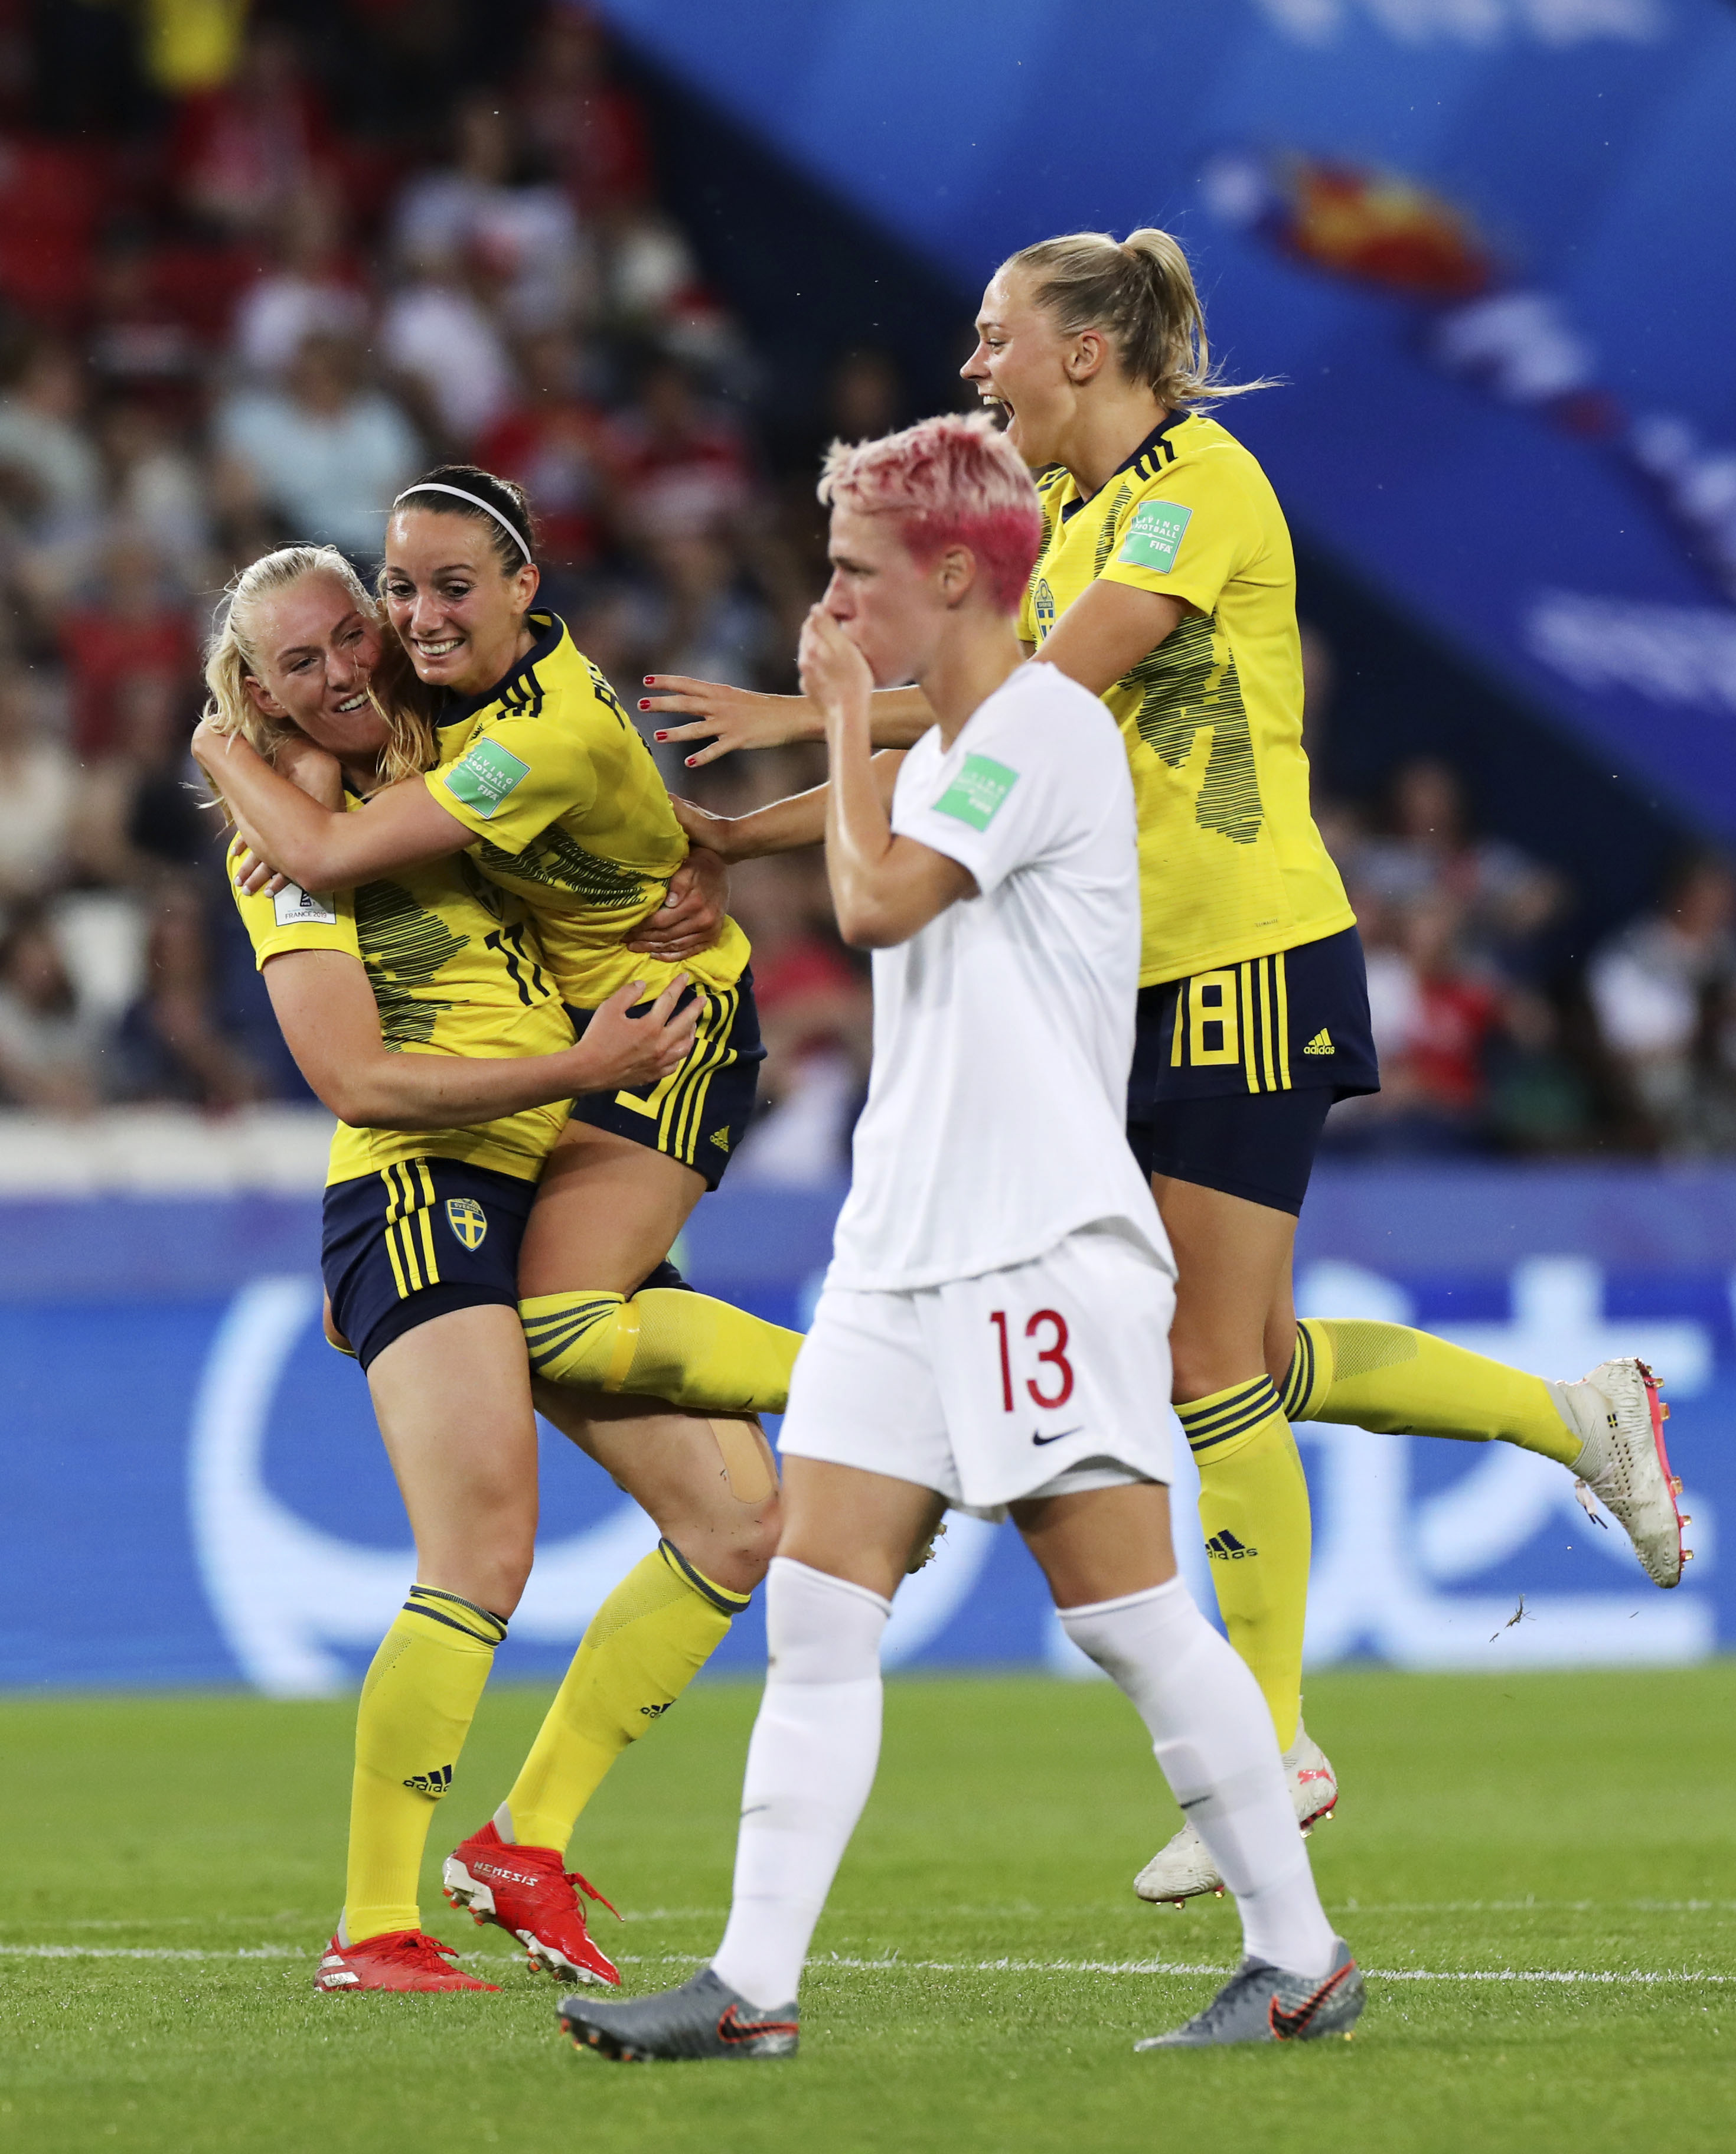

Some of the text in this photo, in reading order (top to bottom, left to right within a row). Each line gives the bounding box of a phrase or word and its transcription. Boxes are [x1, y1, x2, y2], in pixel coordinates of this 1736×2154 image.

[1136, 515, 1181, 532] LIVING
[1149, 540, 1172, 554] FIFA
[468, 758, 507, 790] FOOTBALL
[471, 752, 513, 785] LIVING
[477, 784, 500, 801] FIFA
[285, 911, 312, 919] FRANCE
[484, 922, 551, 1007] 11
[1170, 970, 1239, 1067] 18
[1303, 1045, 1335, 1055] adidas
[990, 1308, 1074, 1413] 13
[1207, 1548, 1259, 1561] didas
[473, 1861, 539, 1887] NEMESIS
